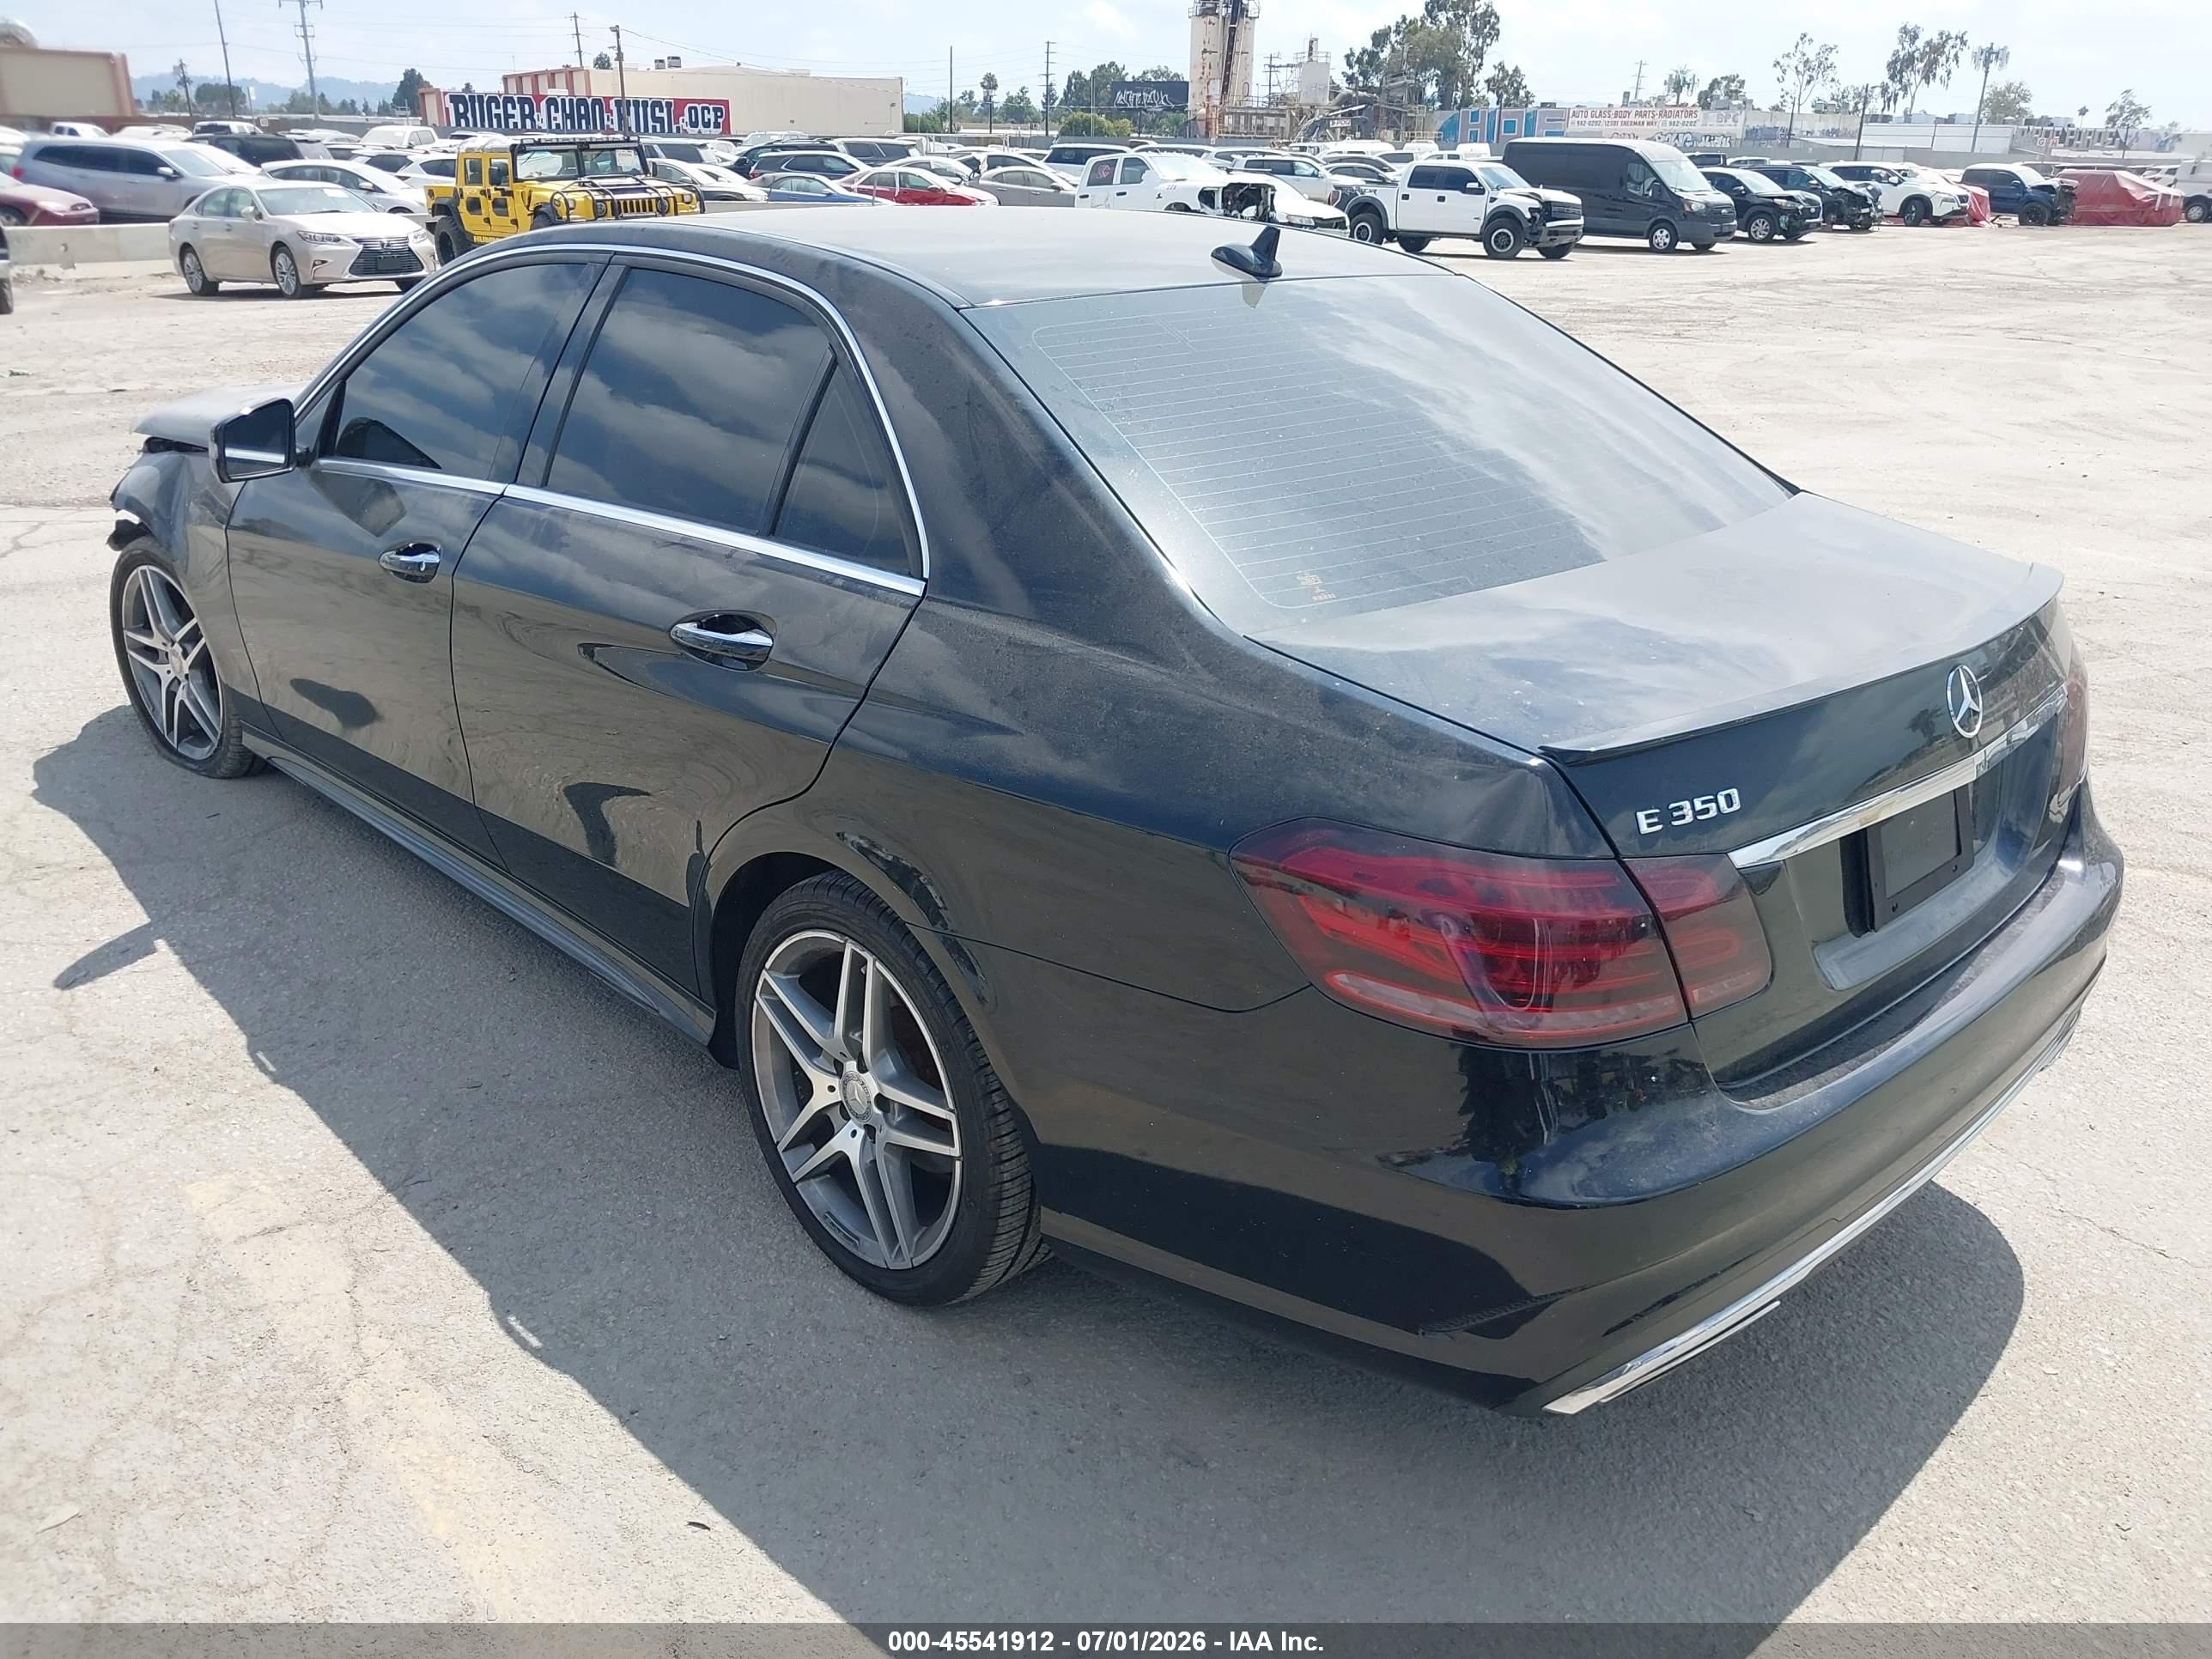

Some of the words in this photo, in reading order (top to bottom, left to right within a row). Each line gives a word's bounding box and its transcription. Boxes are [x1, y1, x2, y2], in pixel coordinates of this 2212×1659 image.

[687, 105, 724, 130] OCP
[1571, 110, 1589, 118] AUTO
[1636, 809, 1664, 835] E
[1668, 787, 1741, 826] 350
